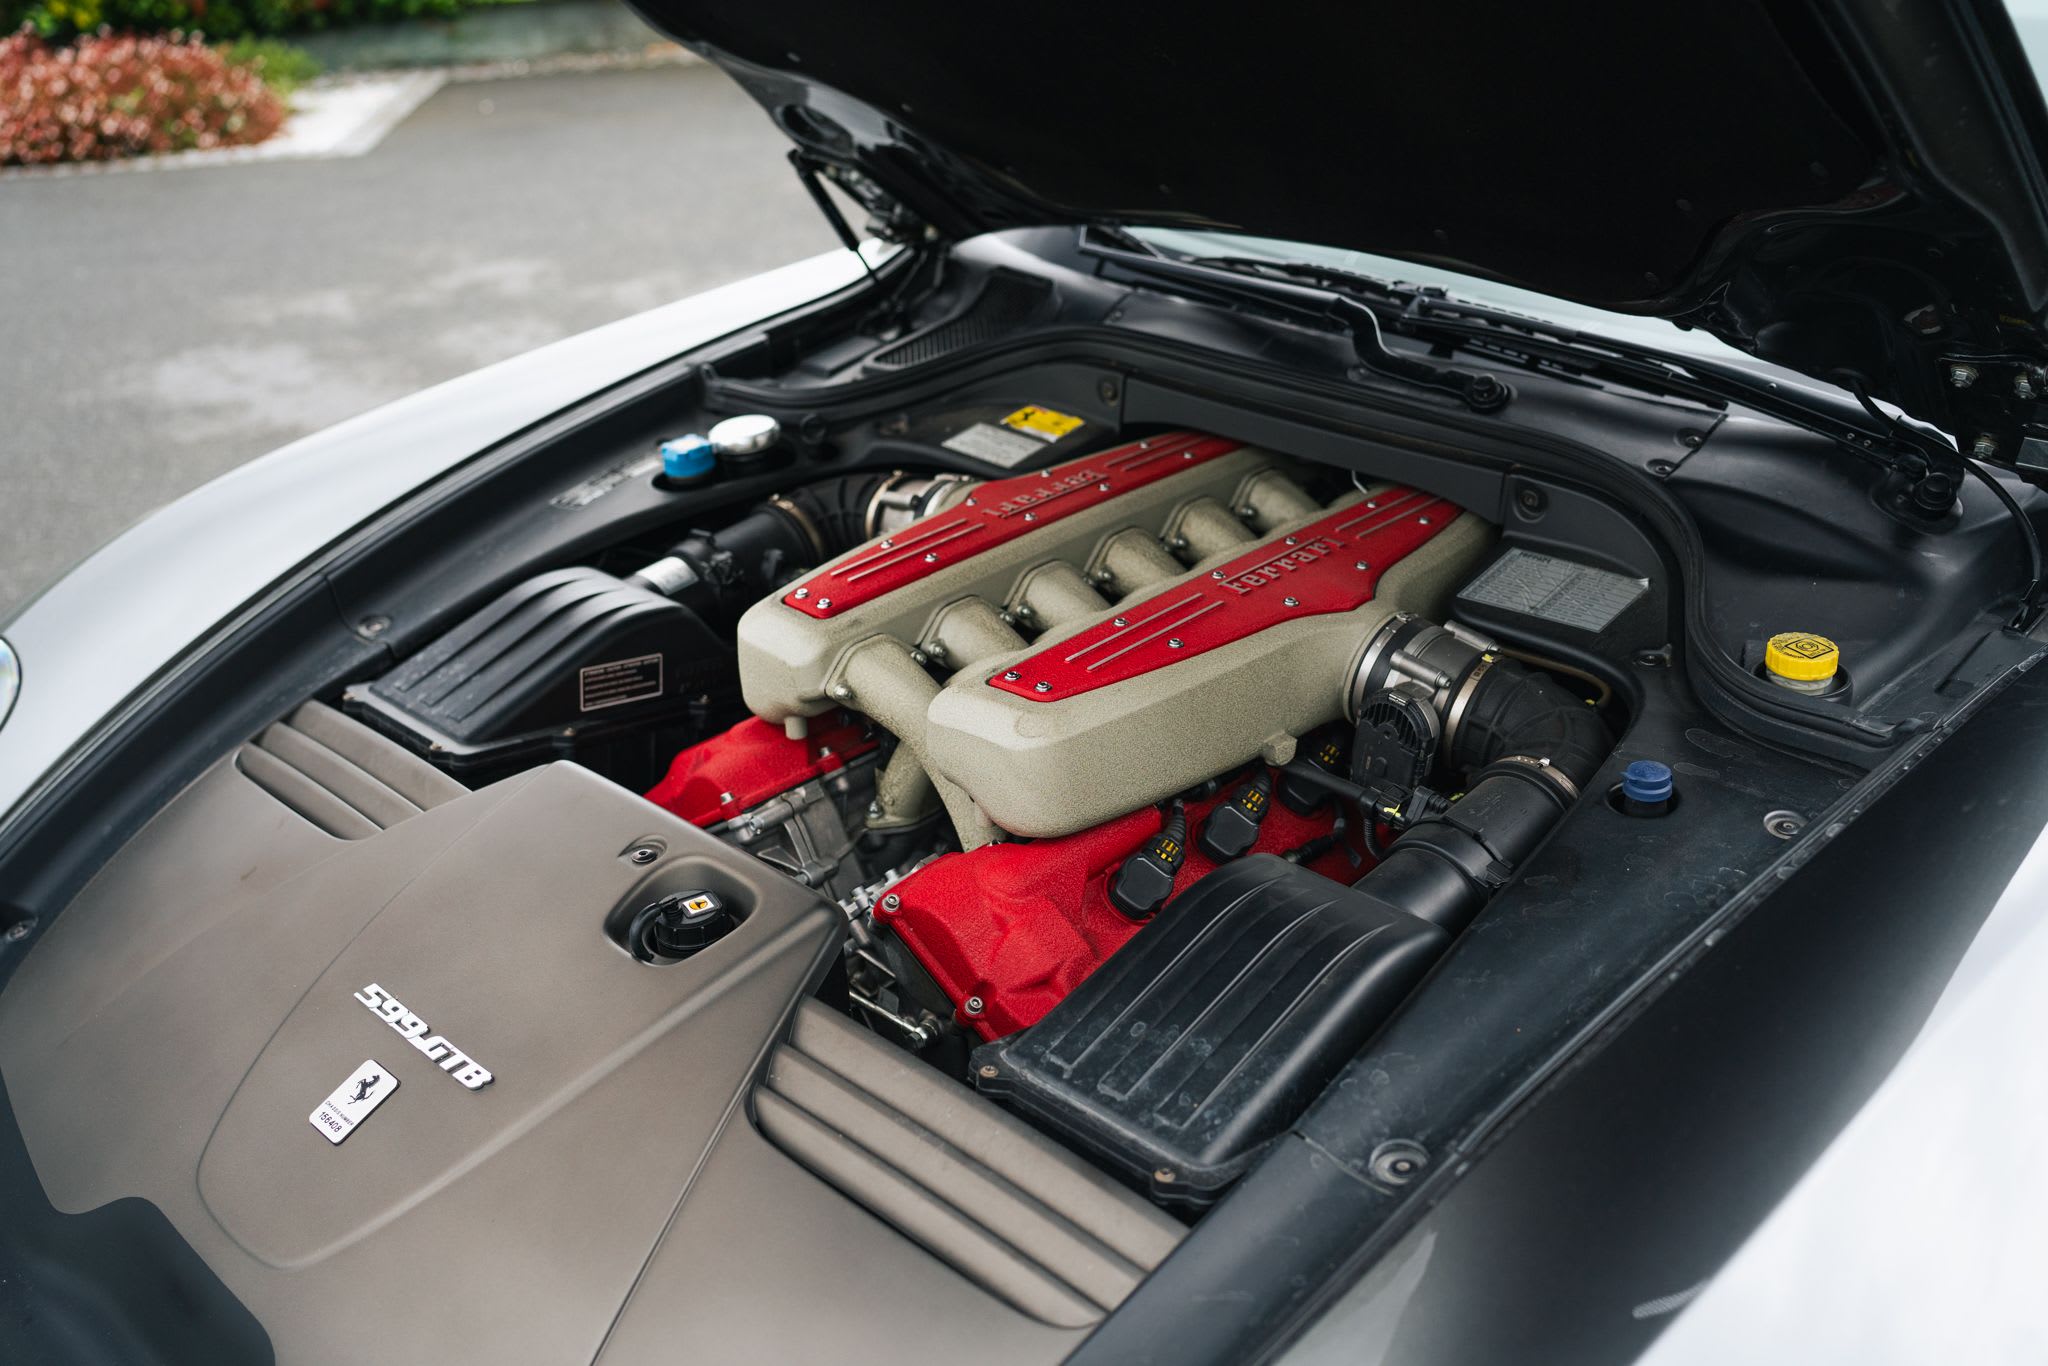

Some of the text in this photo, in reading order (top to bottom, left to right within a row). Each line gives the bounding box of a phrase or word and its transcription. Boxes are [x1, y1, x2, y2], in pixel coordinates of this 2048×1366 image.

[982, 469, 1108, 518] Ferrari
[1217, 536, 1344, 594] Ferrari
[354, 982, 494, 1089] 599 GTB
[319, 1111, 342, 1132] 156408
